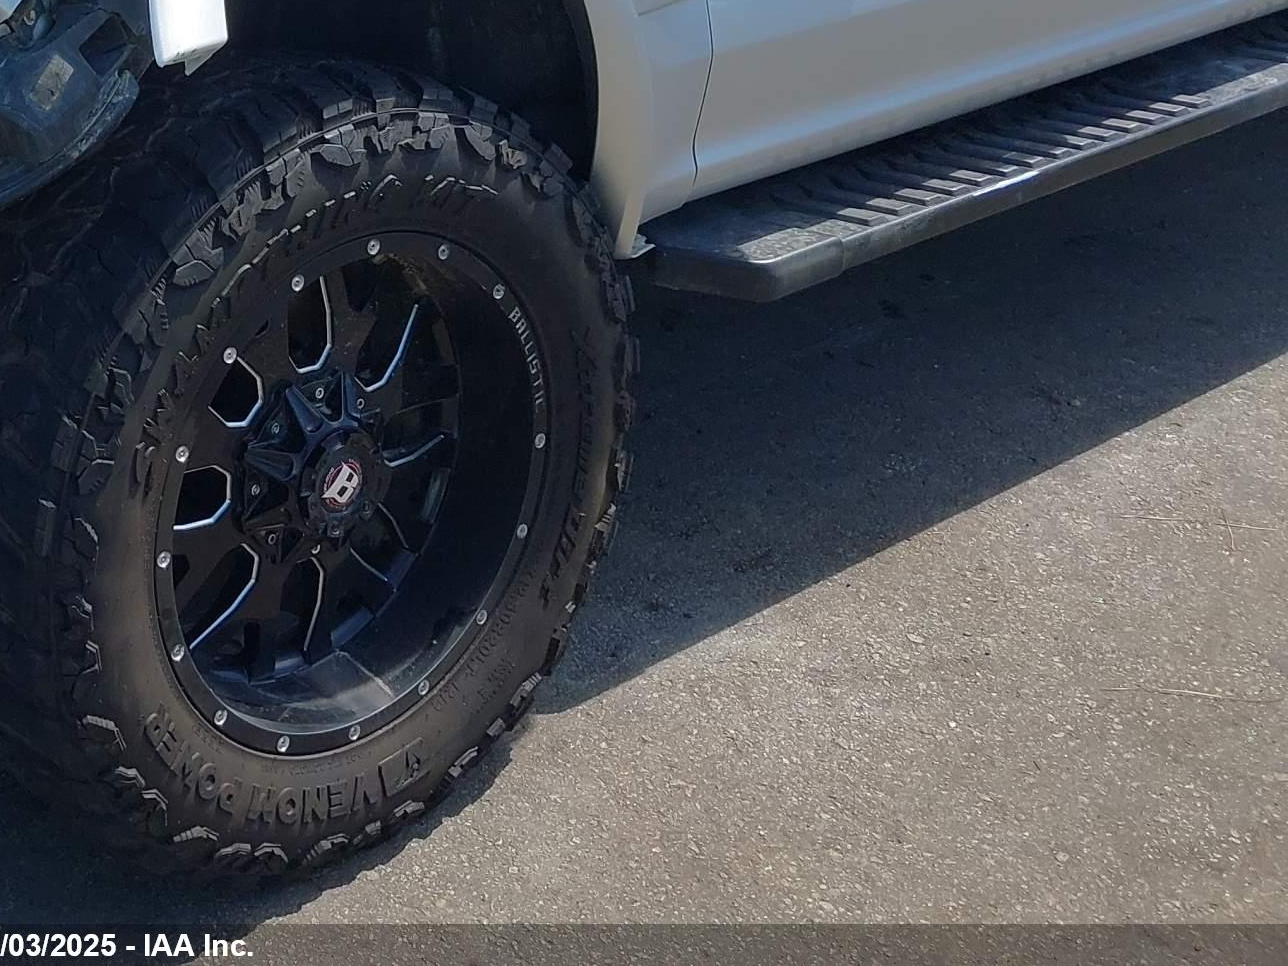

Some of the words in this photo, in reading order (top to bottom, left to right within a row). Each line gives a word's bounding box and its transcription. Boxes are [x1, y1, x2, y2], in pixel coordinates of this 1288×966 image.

[507, 304, 546, 414] BALLISTIC
[142, 704, 243, 816] POWER
[246, 772, 377, 825] VENOM
